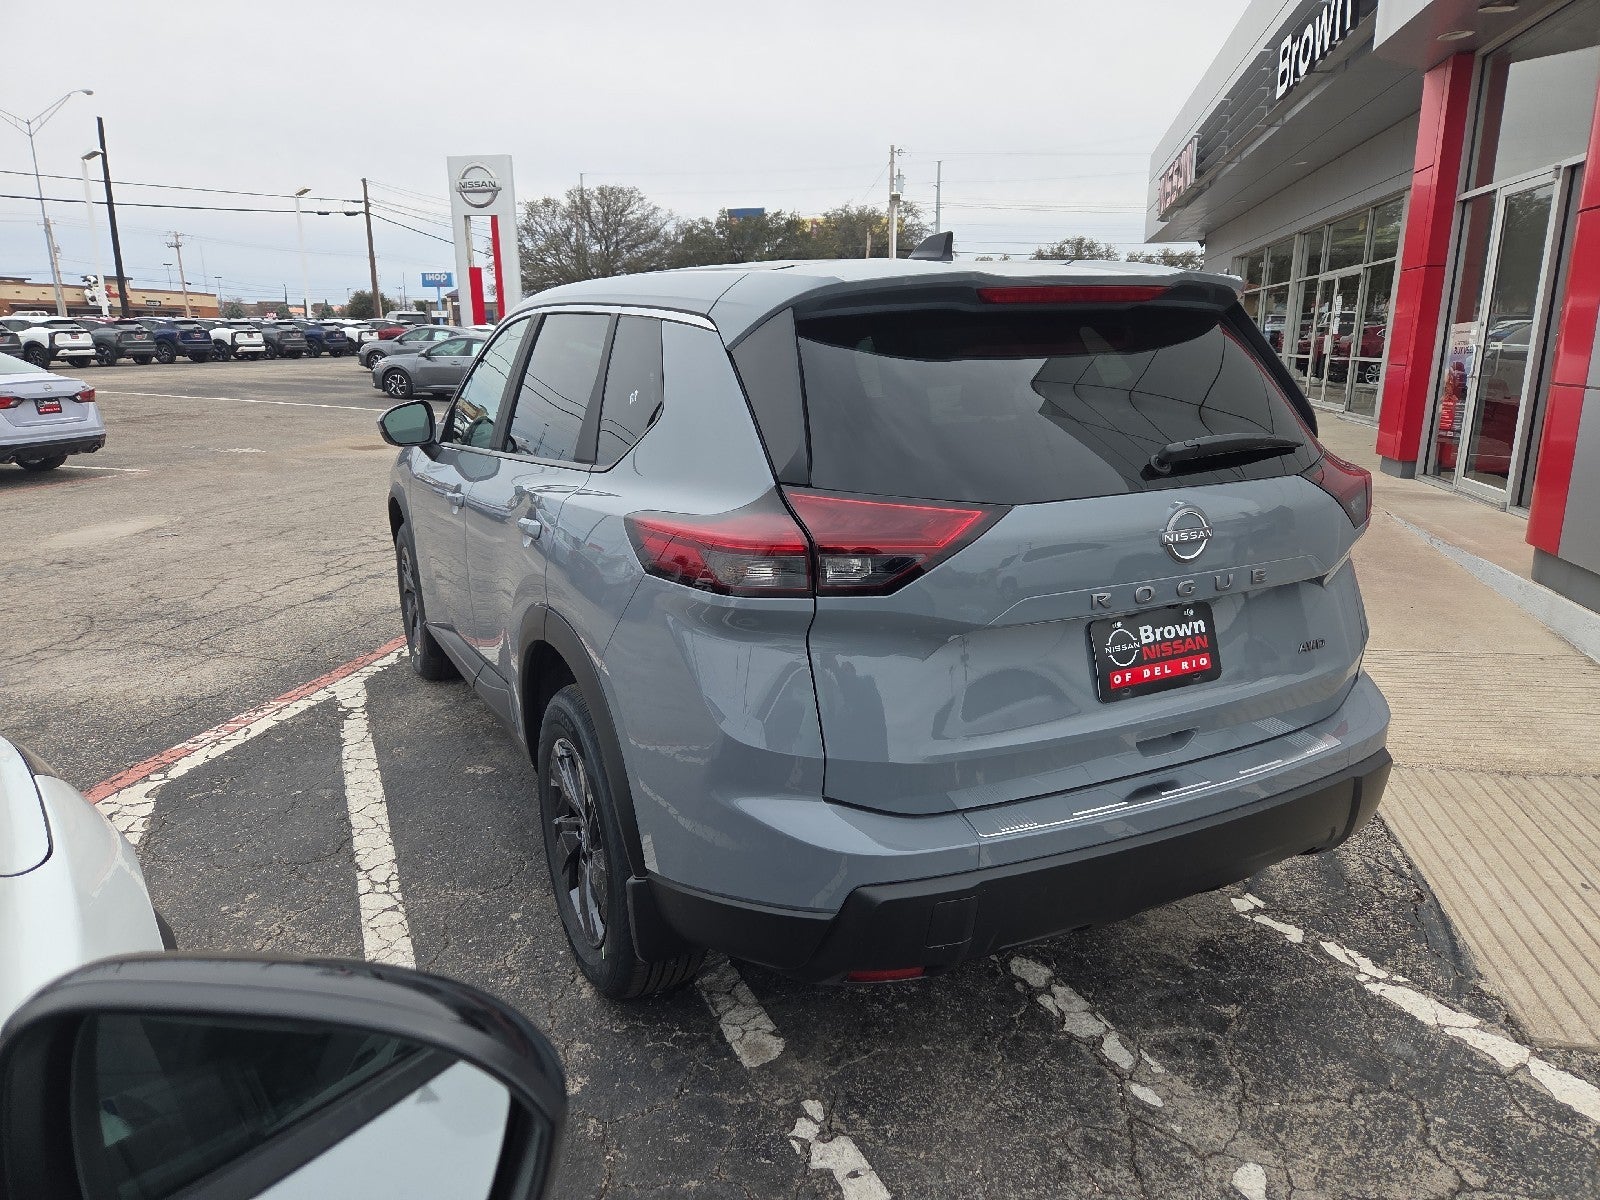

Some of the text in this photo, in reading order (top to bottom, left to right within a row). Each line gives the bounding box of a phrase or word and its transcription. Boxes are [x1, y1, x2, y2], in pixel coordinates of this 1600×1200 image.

[1276, 0, 1352, 100] Brown
[458, 181, 497, 189] NISSAN
[1164, 528, 1213, 543] NISSAN
[1090, 568, 1267, 610] ROGUE
[1138, 618, 1206, 644] Brown
[1104, 640, 1141, 655] NISSAN
[1142, 634, 1209, 661] NISSAN
[1113, 656, 1208, 684] OF DEL RIO
